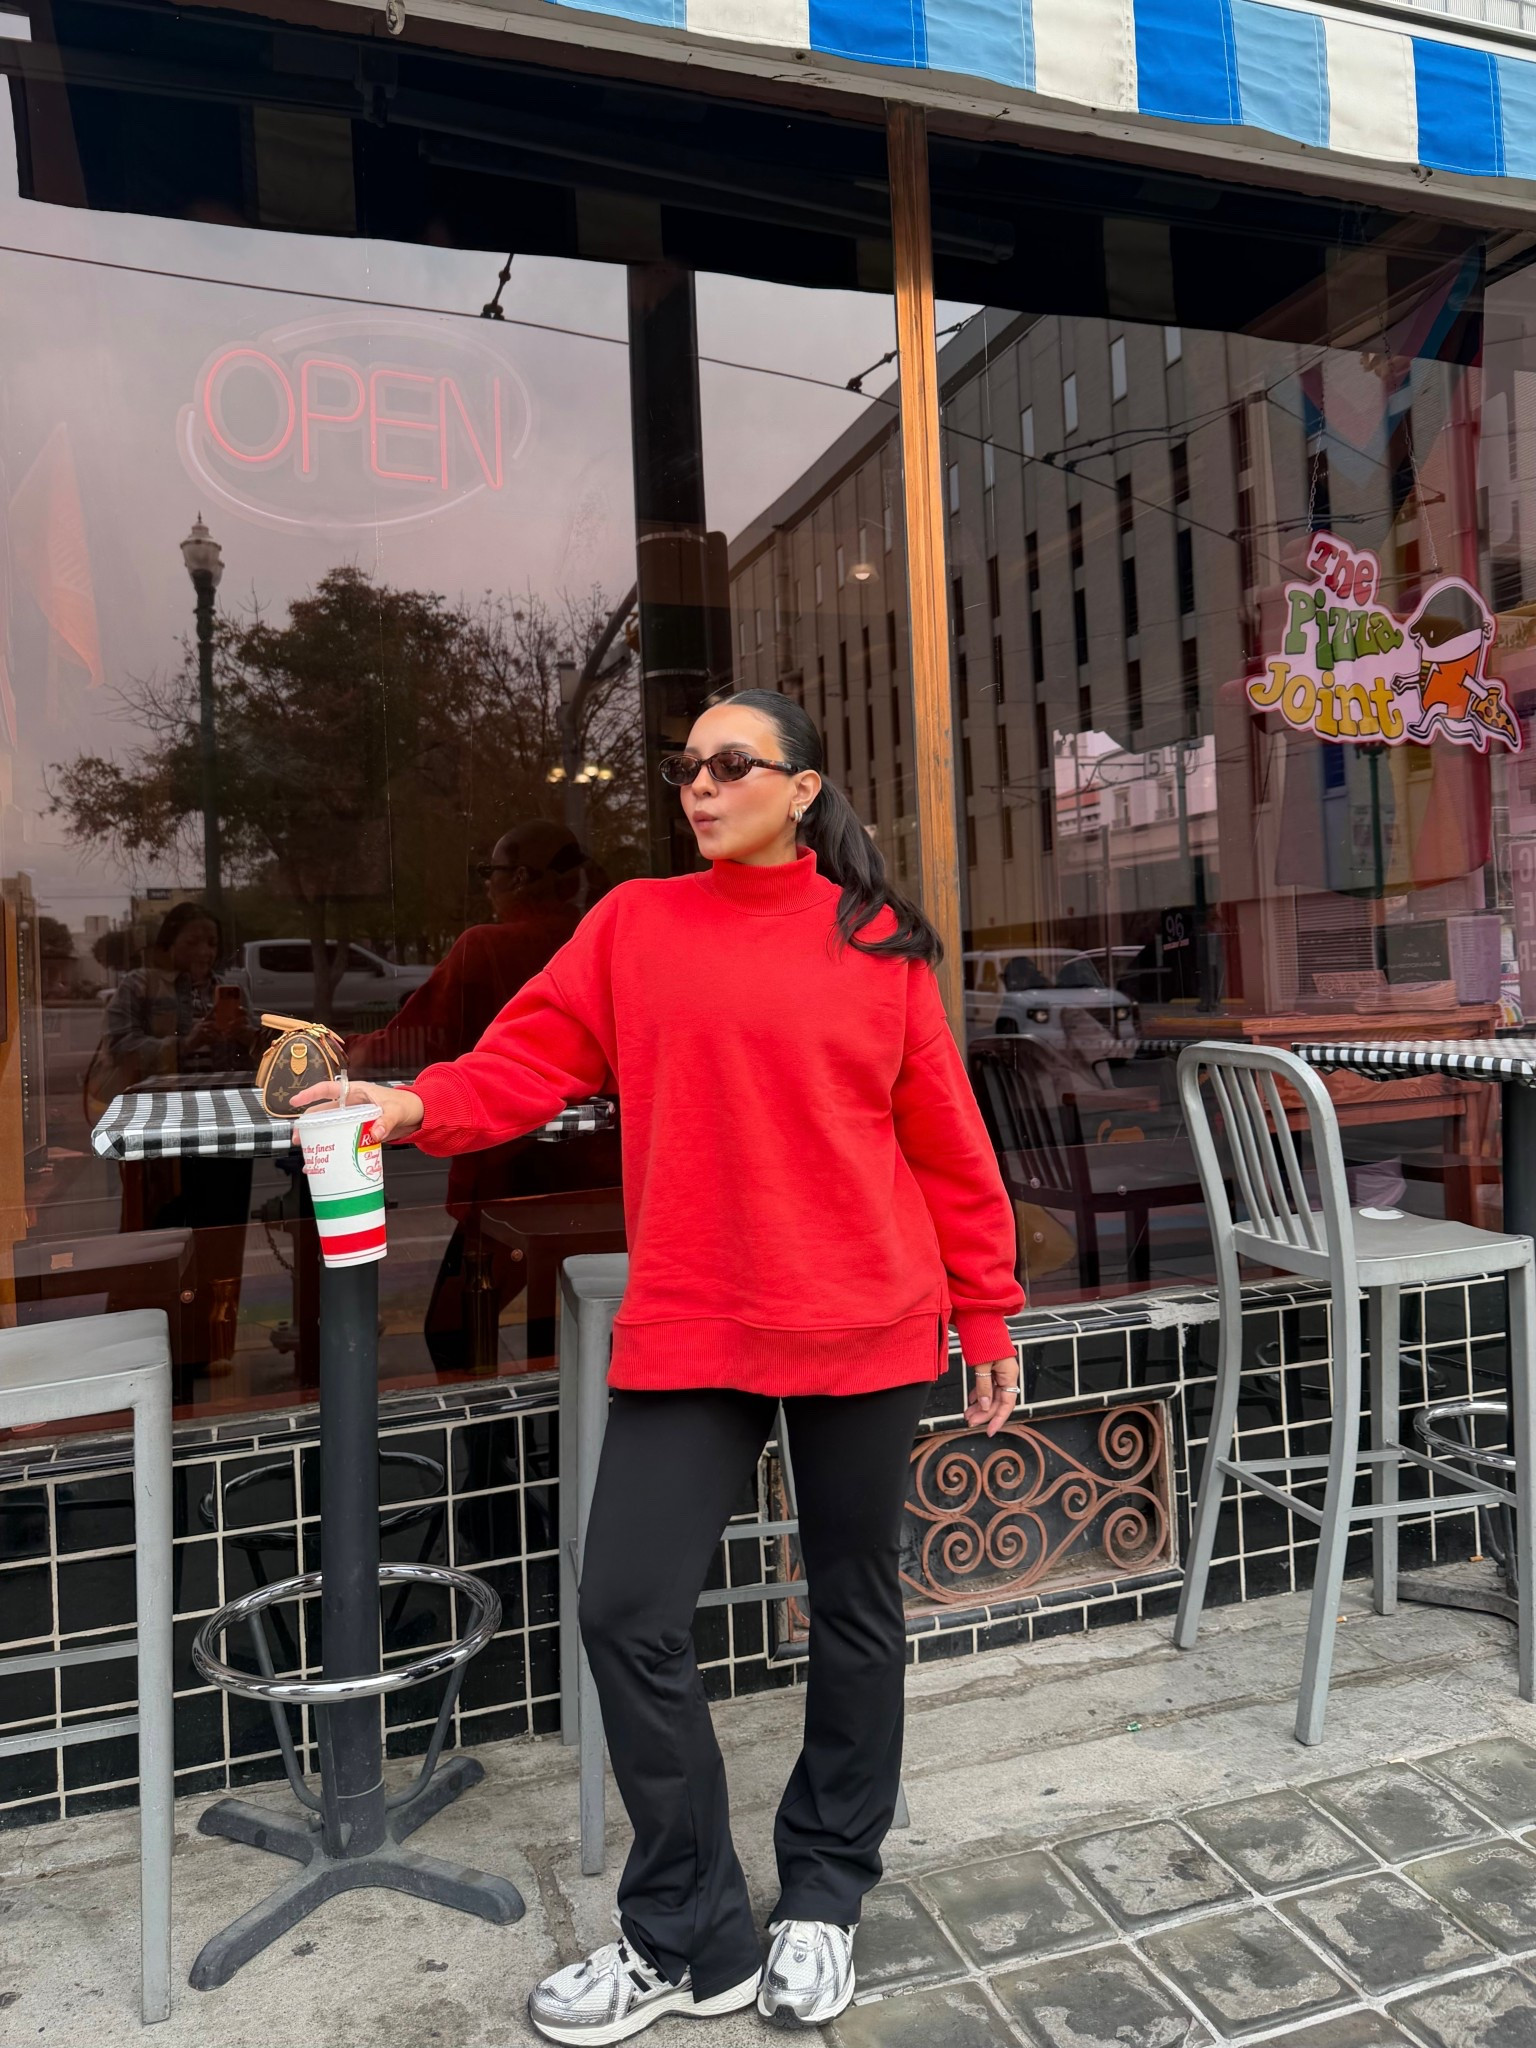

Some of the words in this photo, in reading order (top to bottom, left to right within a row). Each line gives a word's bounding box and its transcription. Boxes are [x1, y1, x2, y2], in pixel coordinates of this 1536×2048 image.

[204, 348, 503, 490] OPEN
[1310, 540, 1375, 606] The
[1284, 588, 1405, 671] Pizza
[1248, 661, 1404, 739] Joint
[314, 1154, 329, 1167] food
[315, 1143, 336, 1156] finest
